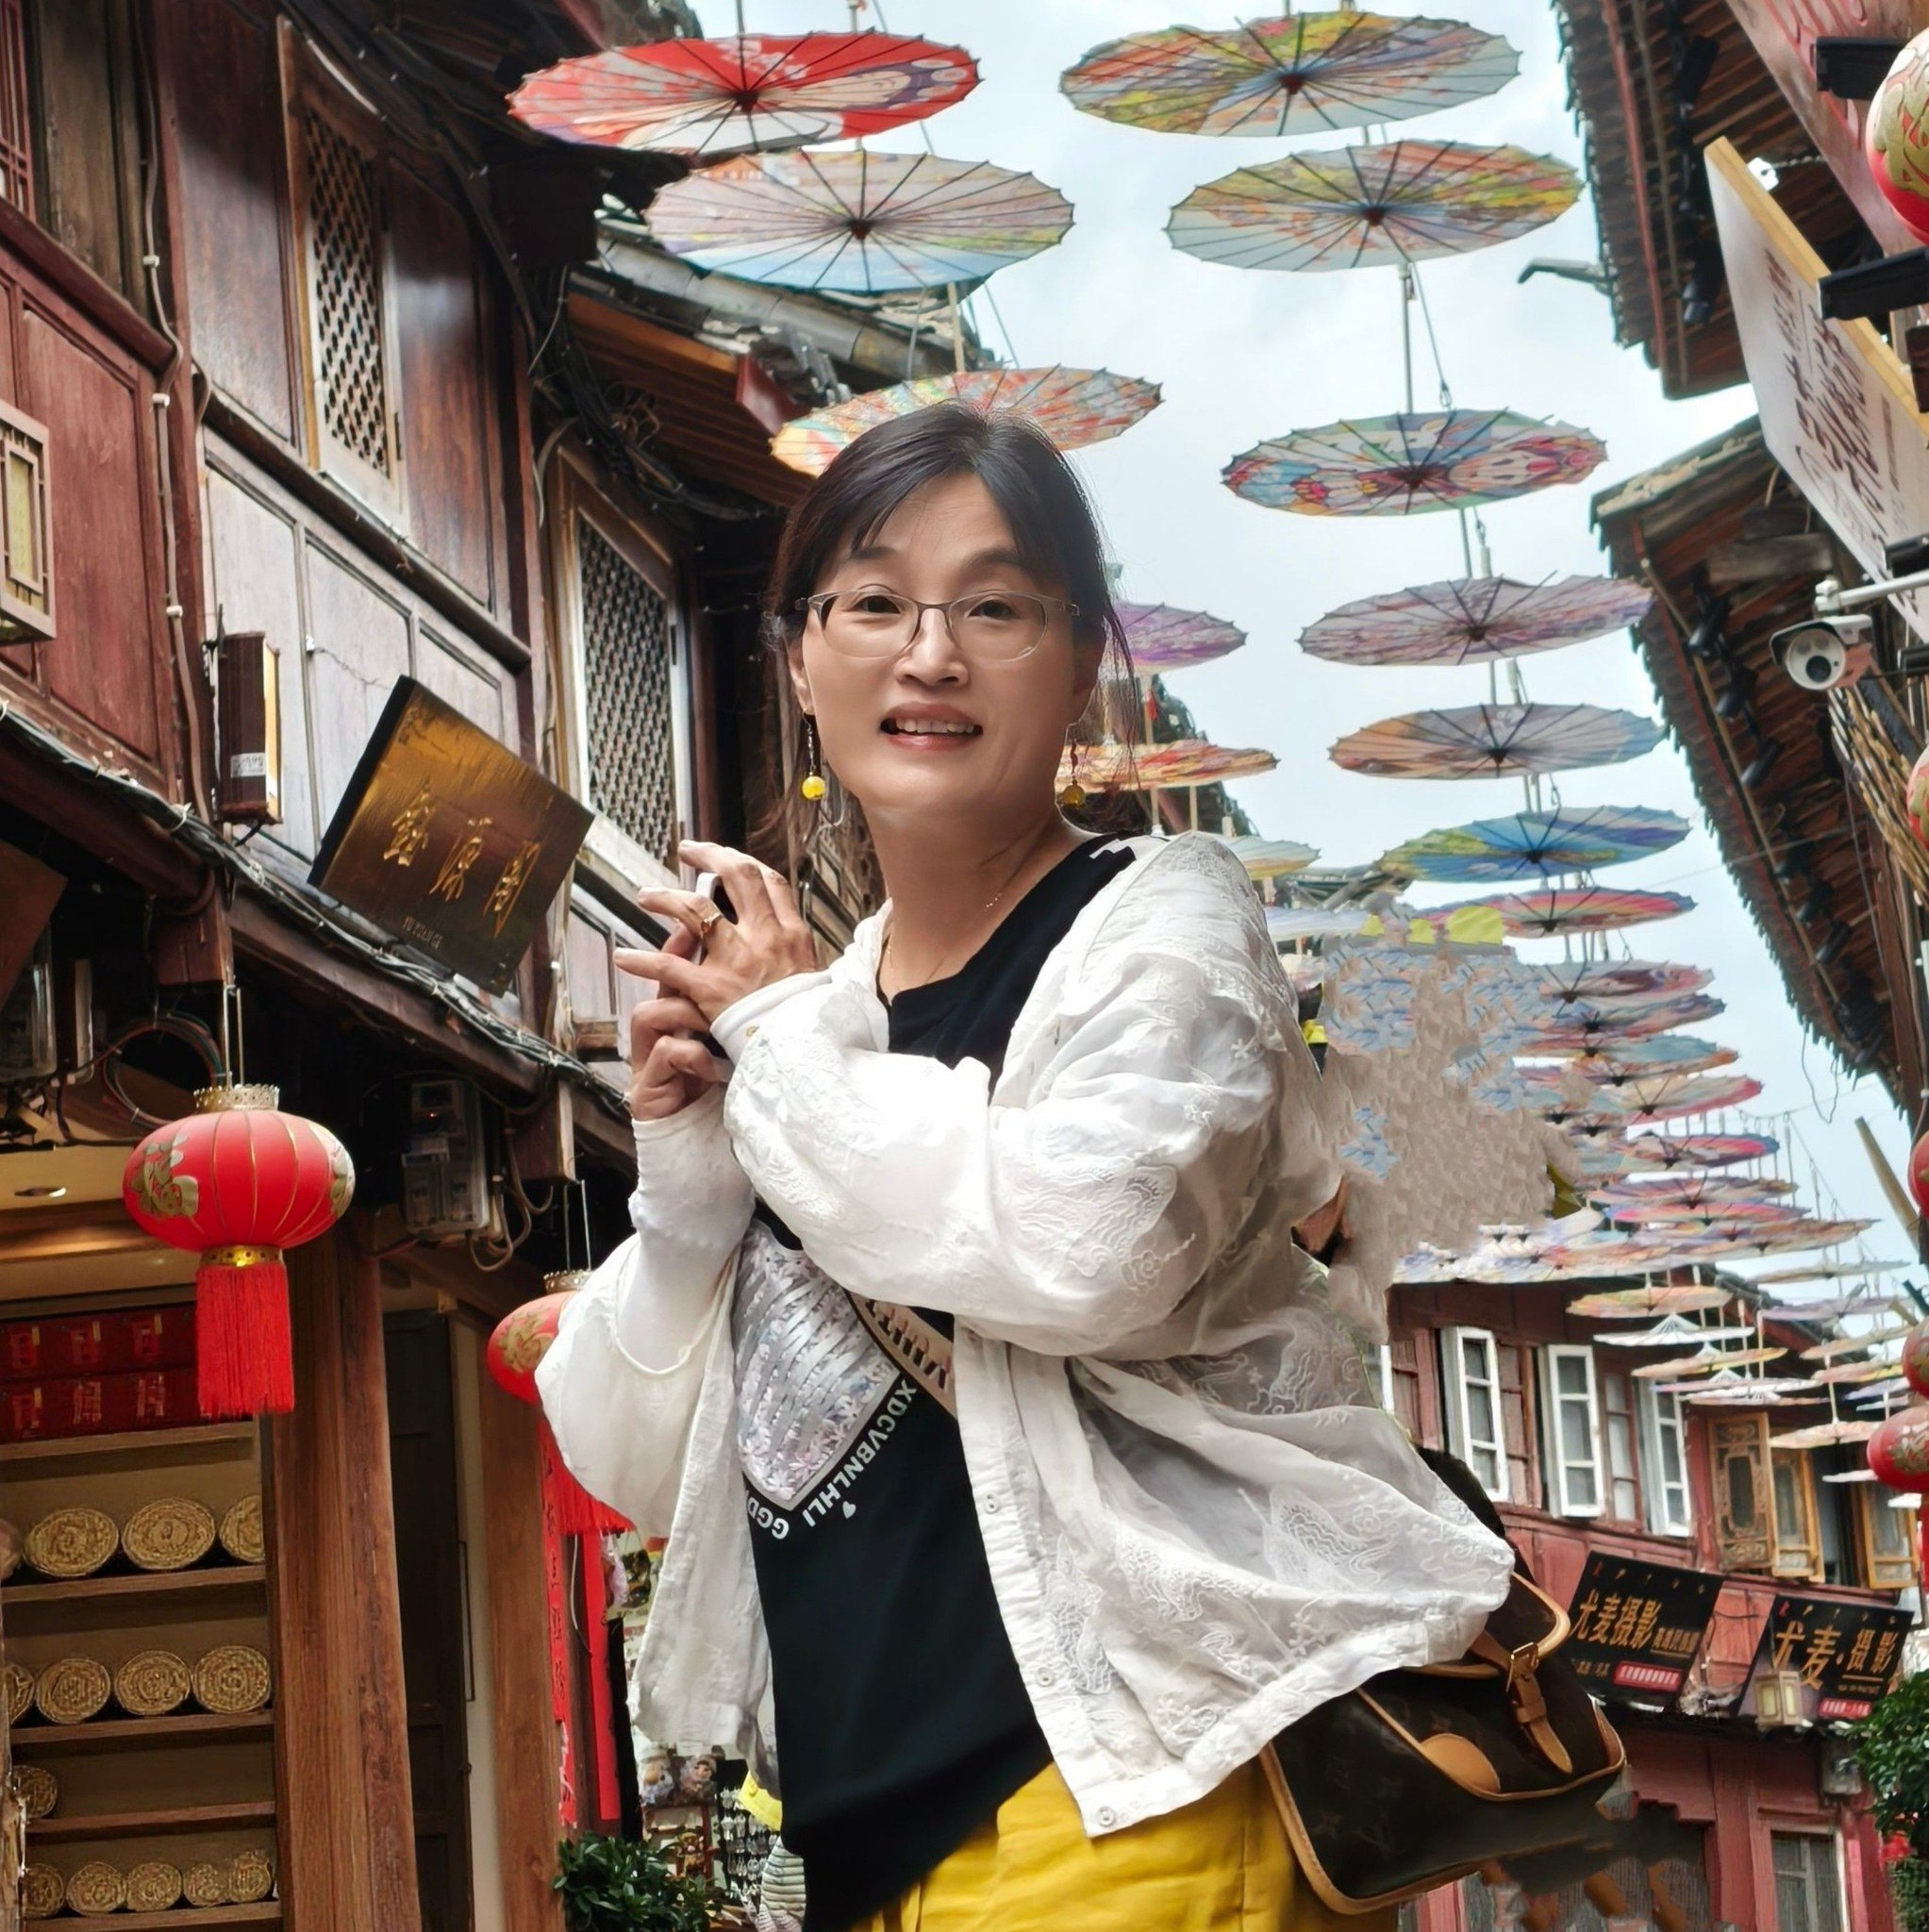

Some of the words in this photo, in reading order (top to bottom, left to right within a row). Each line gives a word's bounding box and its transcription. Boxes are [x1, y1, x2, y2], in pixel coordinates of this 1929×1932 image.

[746, 1491, 790, 1540] GGD
[1571, 1589, 1661, 1651] 尤麦摄影
